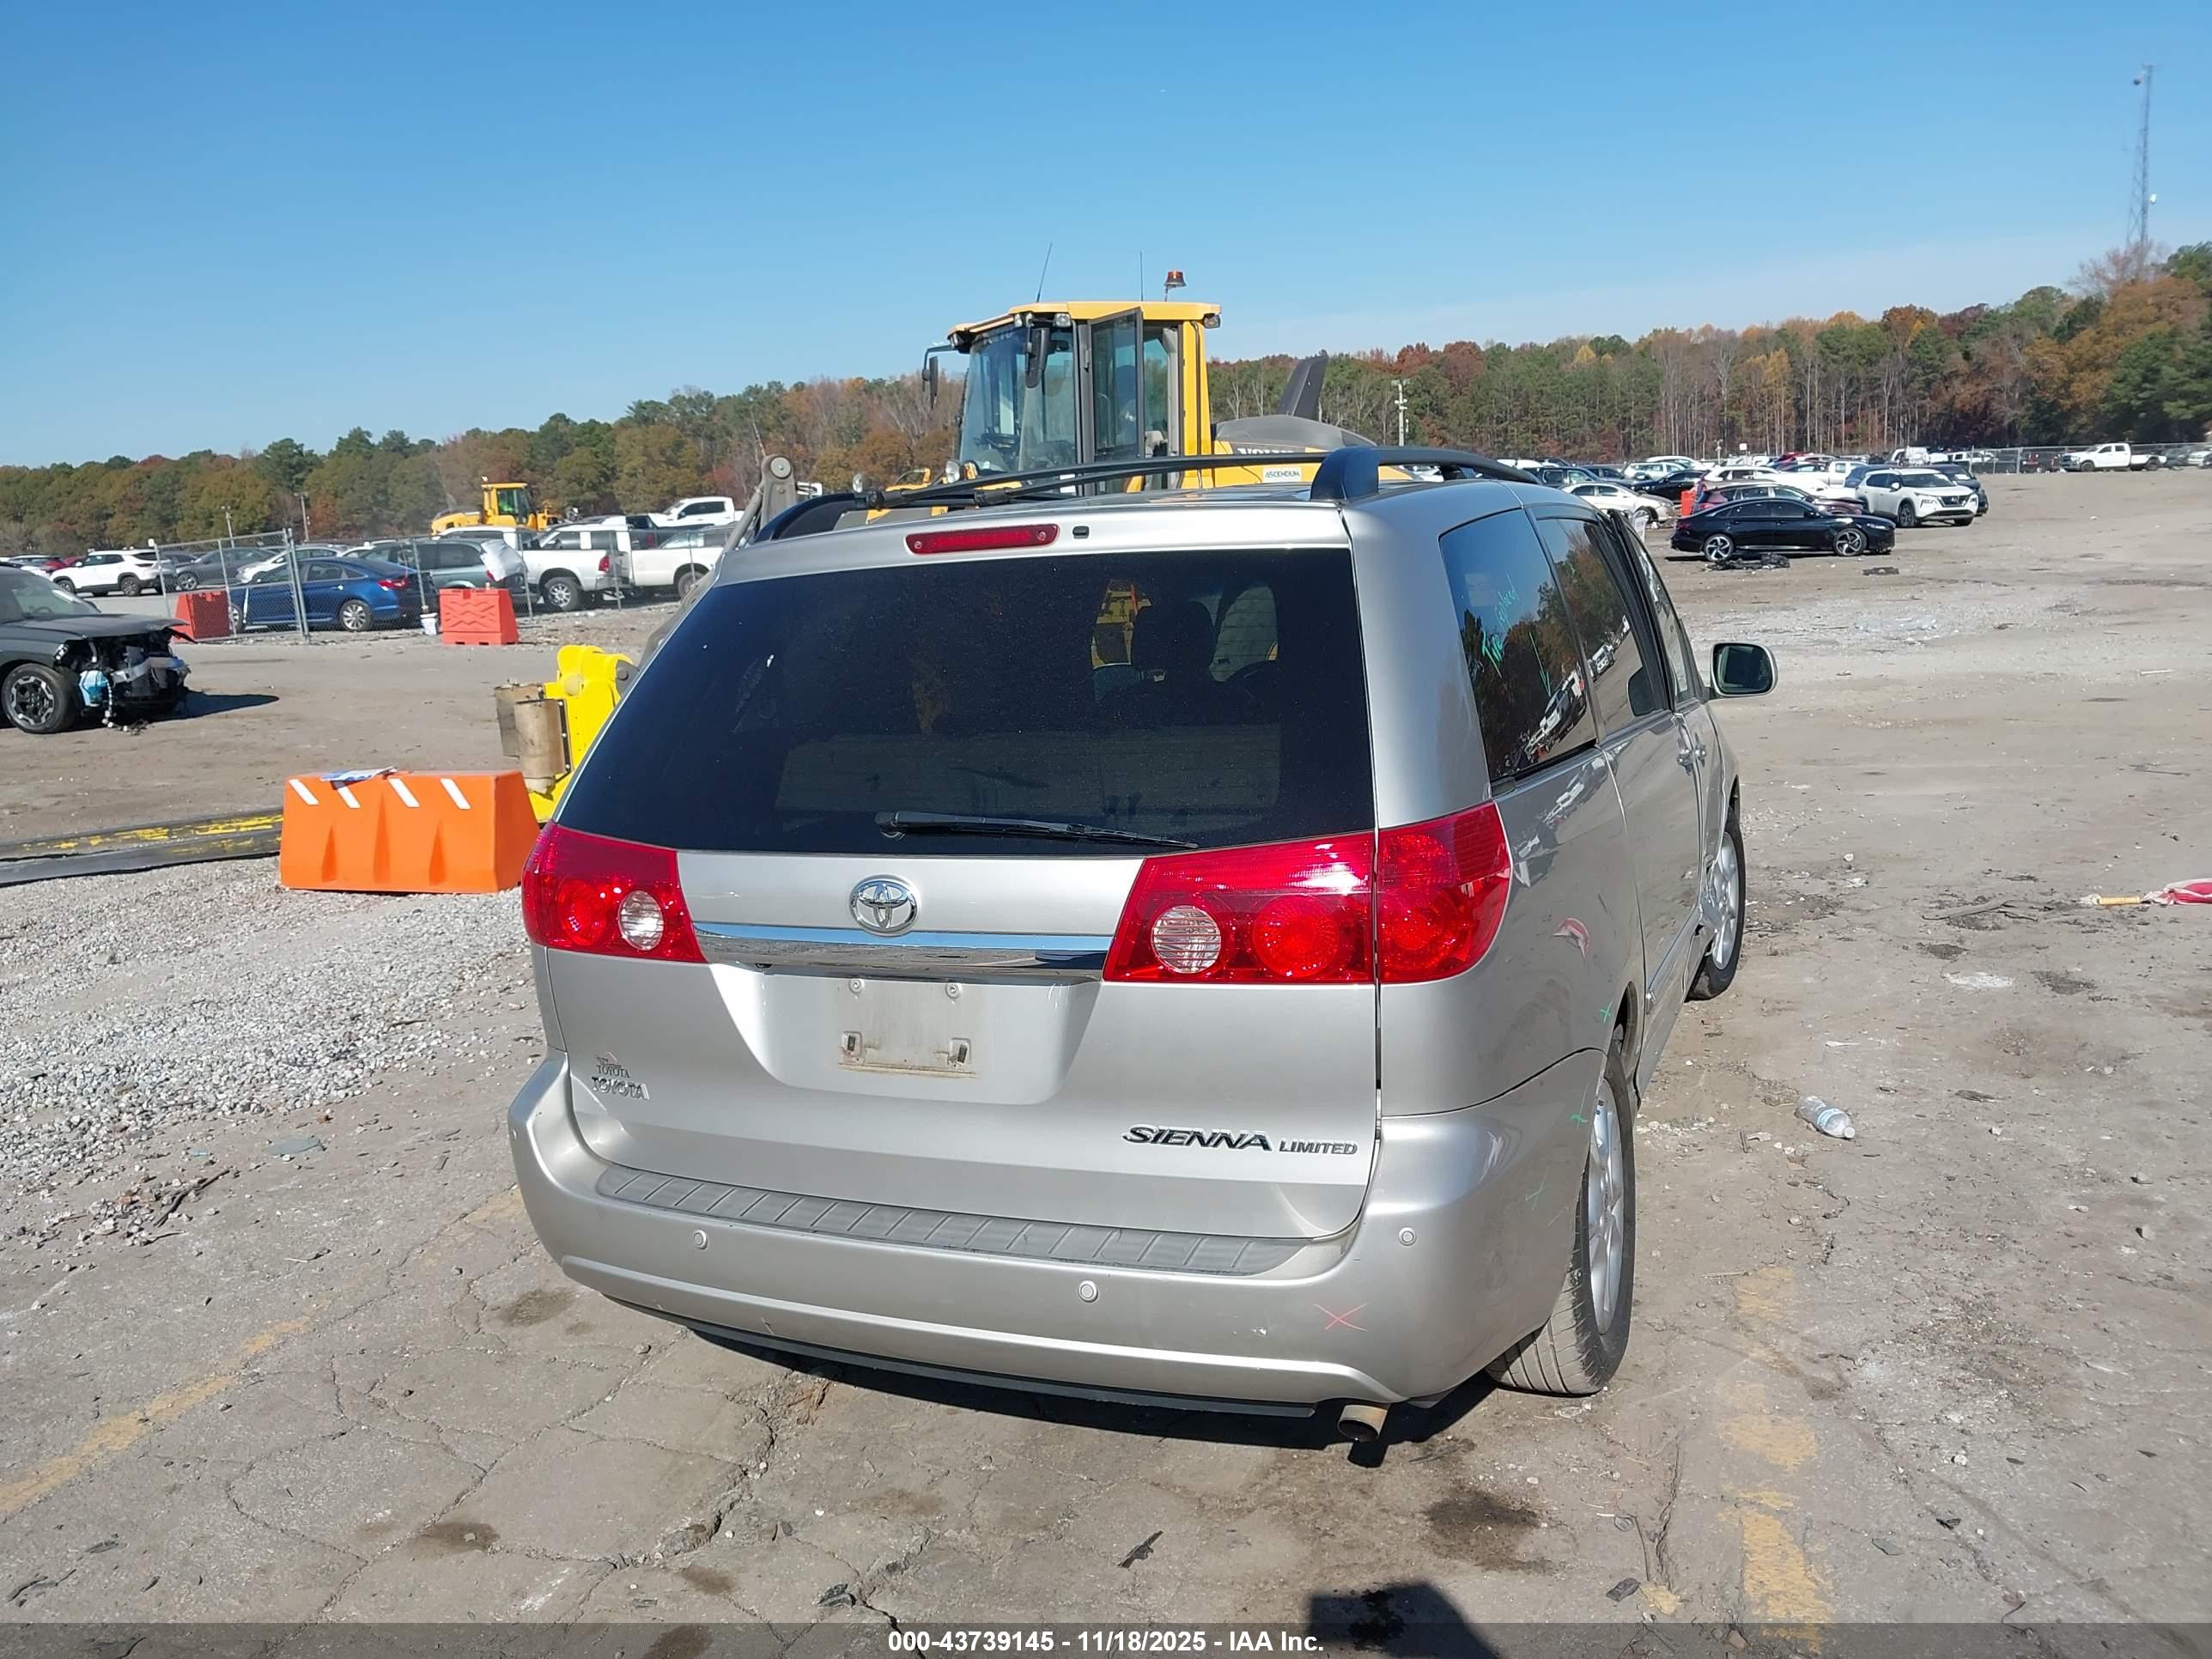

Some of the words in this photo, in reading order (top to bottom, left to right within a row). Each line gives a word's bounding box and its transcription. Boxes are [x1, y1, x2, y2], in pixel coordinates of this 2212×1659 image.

[1265, 469, 1300, 479] ASCENDUM
[596, 1064, 631, 1079] TOYOTA
[591, 1076, 650, 1101] TOYOTA
[1122, 1124, 1273, 1152] SIENNA
[1279, 1139, 1358, 1156] LIMITED
